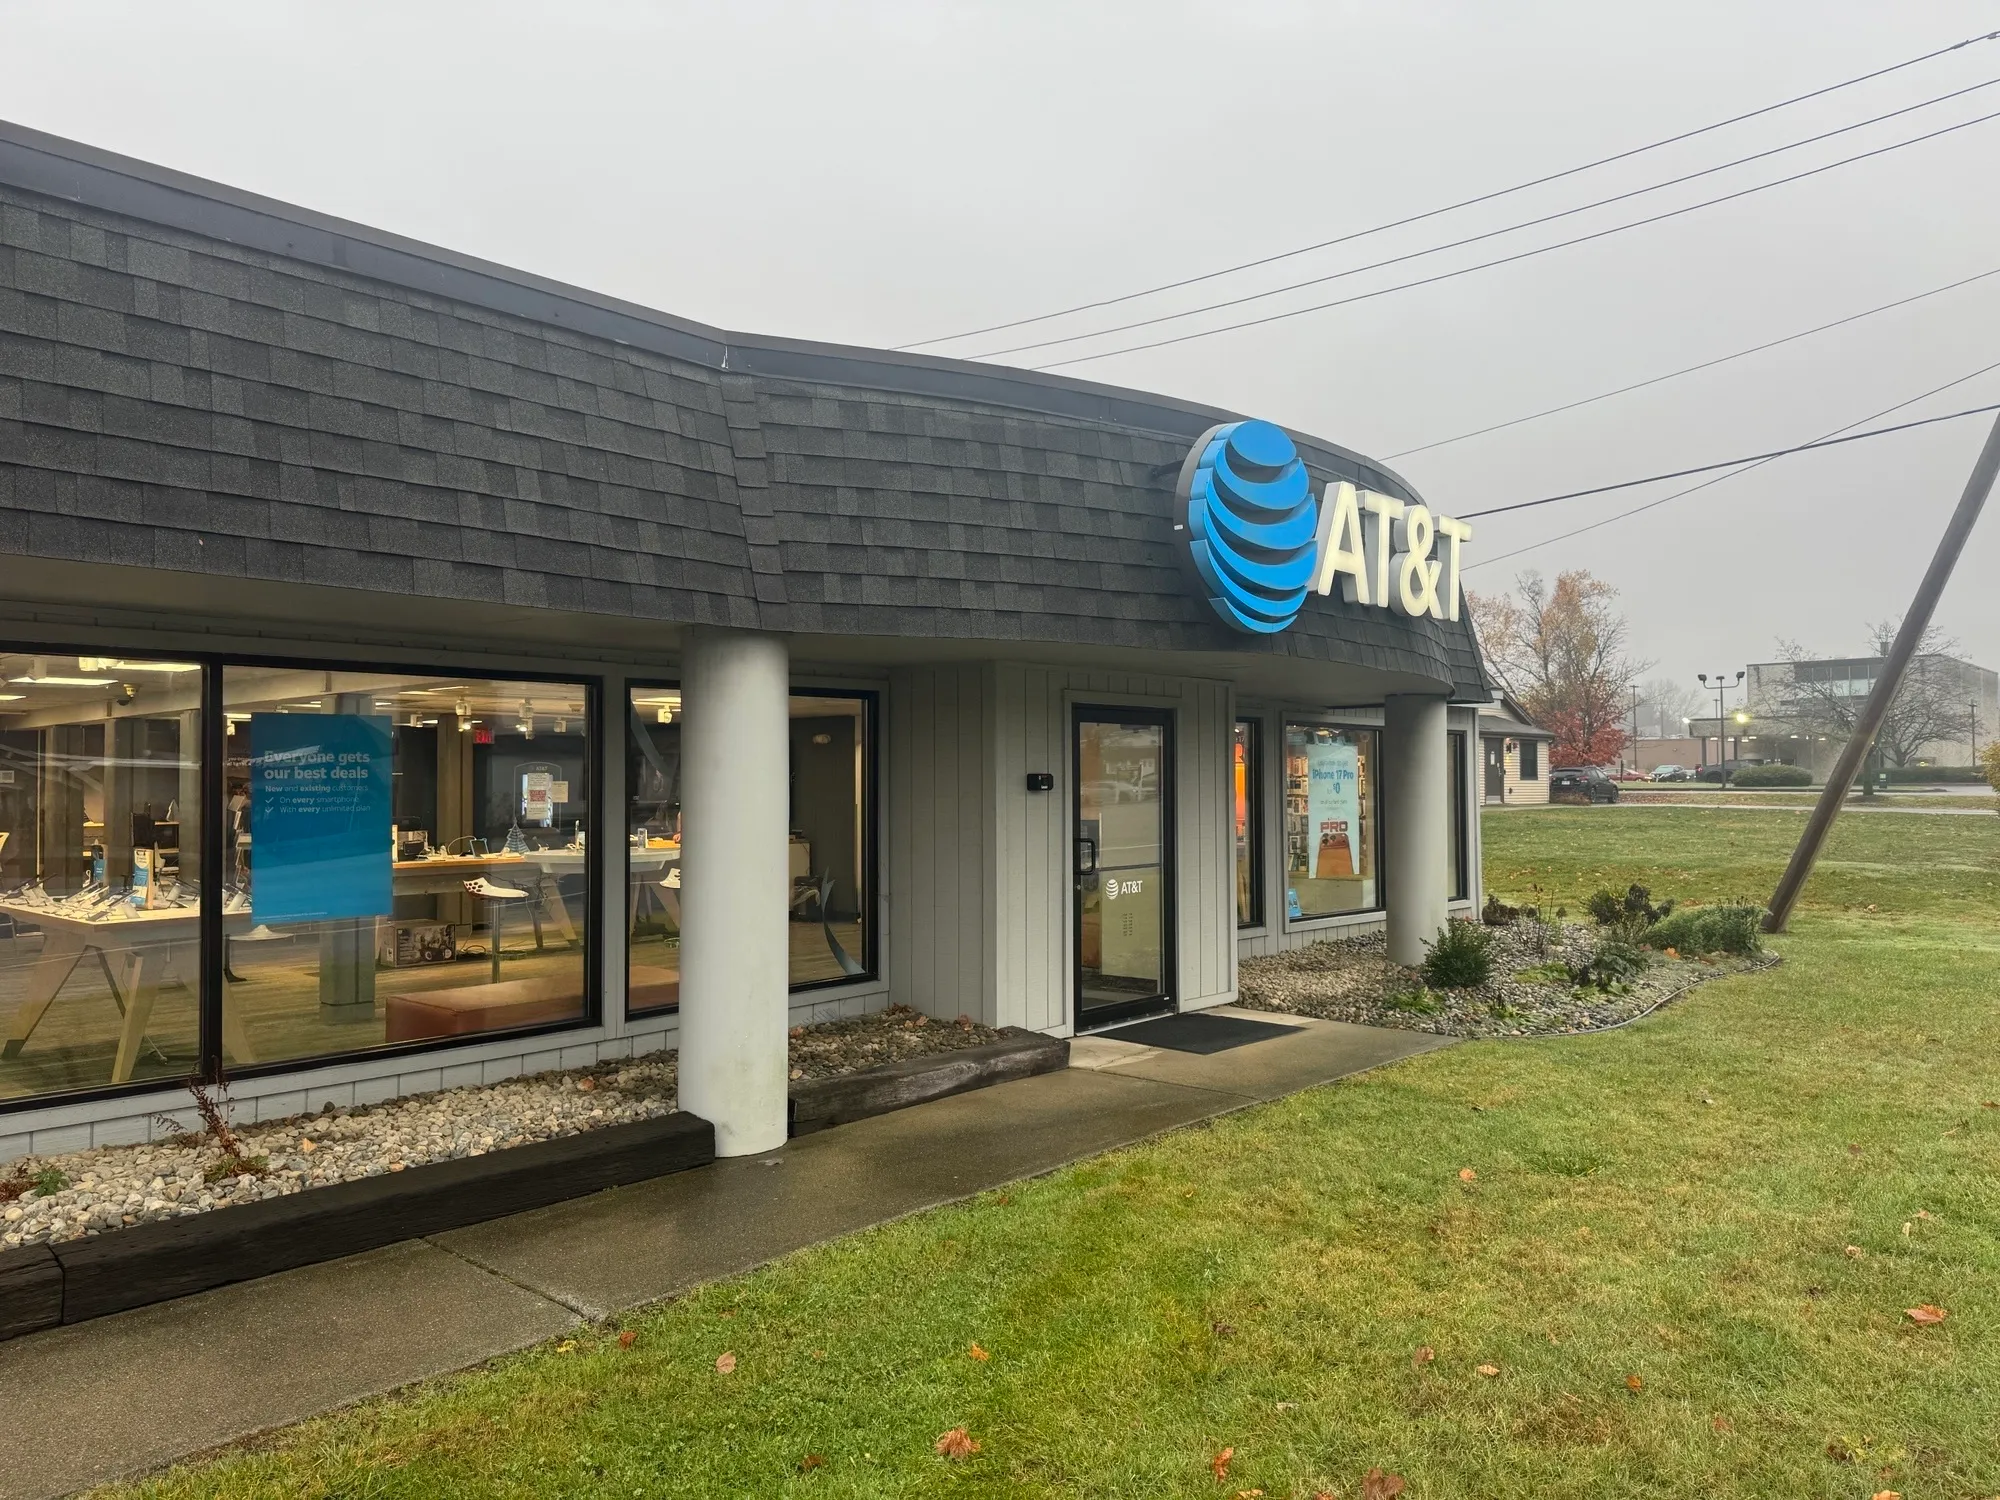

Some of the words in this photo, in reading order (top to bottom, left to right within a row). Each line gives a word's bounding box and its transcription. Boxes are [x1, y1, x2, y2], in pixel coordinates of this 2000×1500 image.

[1315, 481, 1473, 622] AT&T
[264, 750, 335, 765] Everyone
[338, 751, 371, 765] gets
[264, 768, 291, 779] our
[294, 766, 328, 779] best
[330, 766, 369, 779] deals
[1312, 768, 1335, 780] iPhone
[1336, 769, 1343, 780] 17
[1343, 769, 1354, 780] Pro
[265, 785, 283, 793] New
[300, 784, 331, 794] existing
[332, 784, 369, 792] customers
[1333, 782, 1340, 794] $0
[280, 796, 291, 804] On
[292, 796, 315, 805] every
[316, 795, 360, 804] smartphone
[280, 806, 297, 814] With
[298, 806, 321, 814] every
[322, 805, 354, 813] unlimited
[355, 804, 371, 813] plan
[1320, 821, 1348, 833] PRO
[1121, 880, 1143, 895] AT&T
